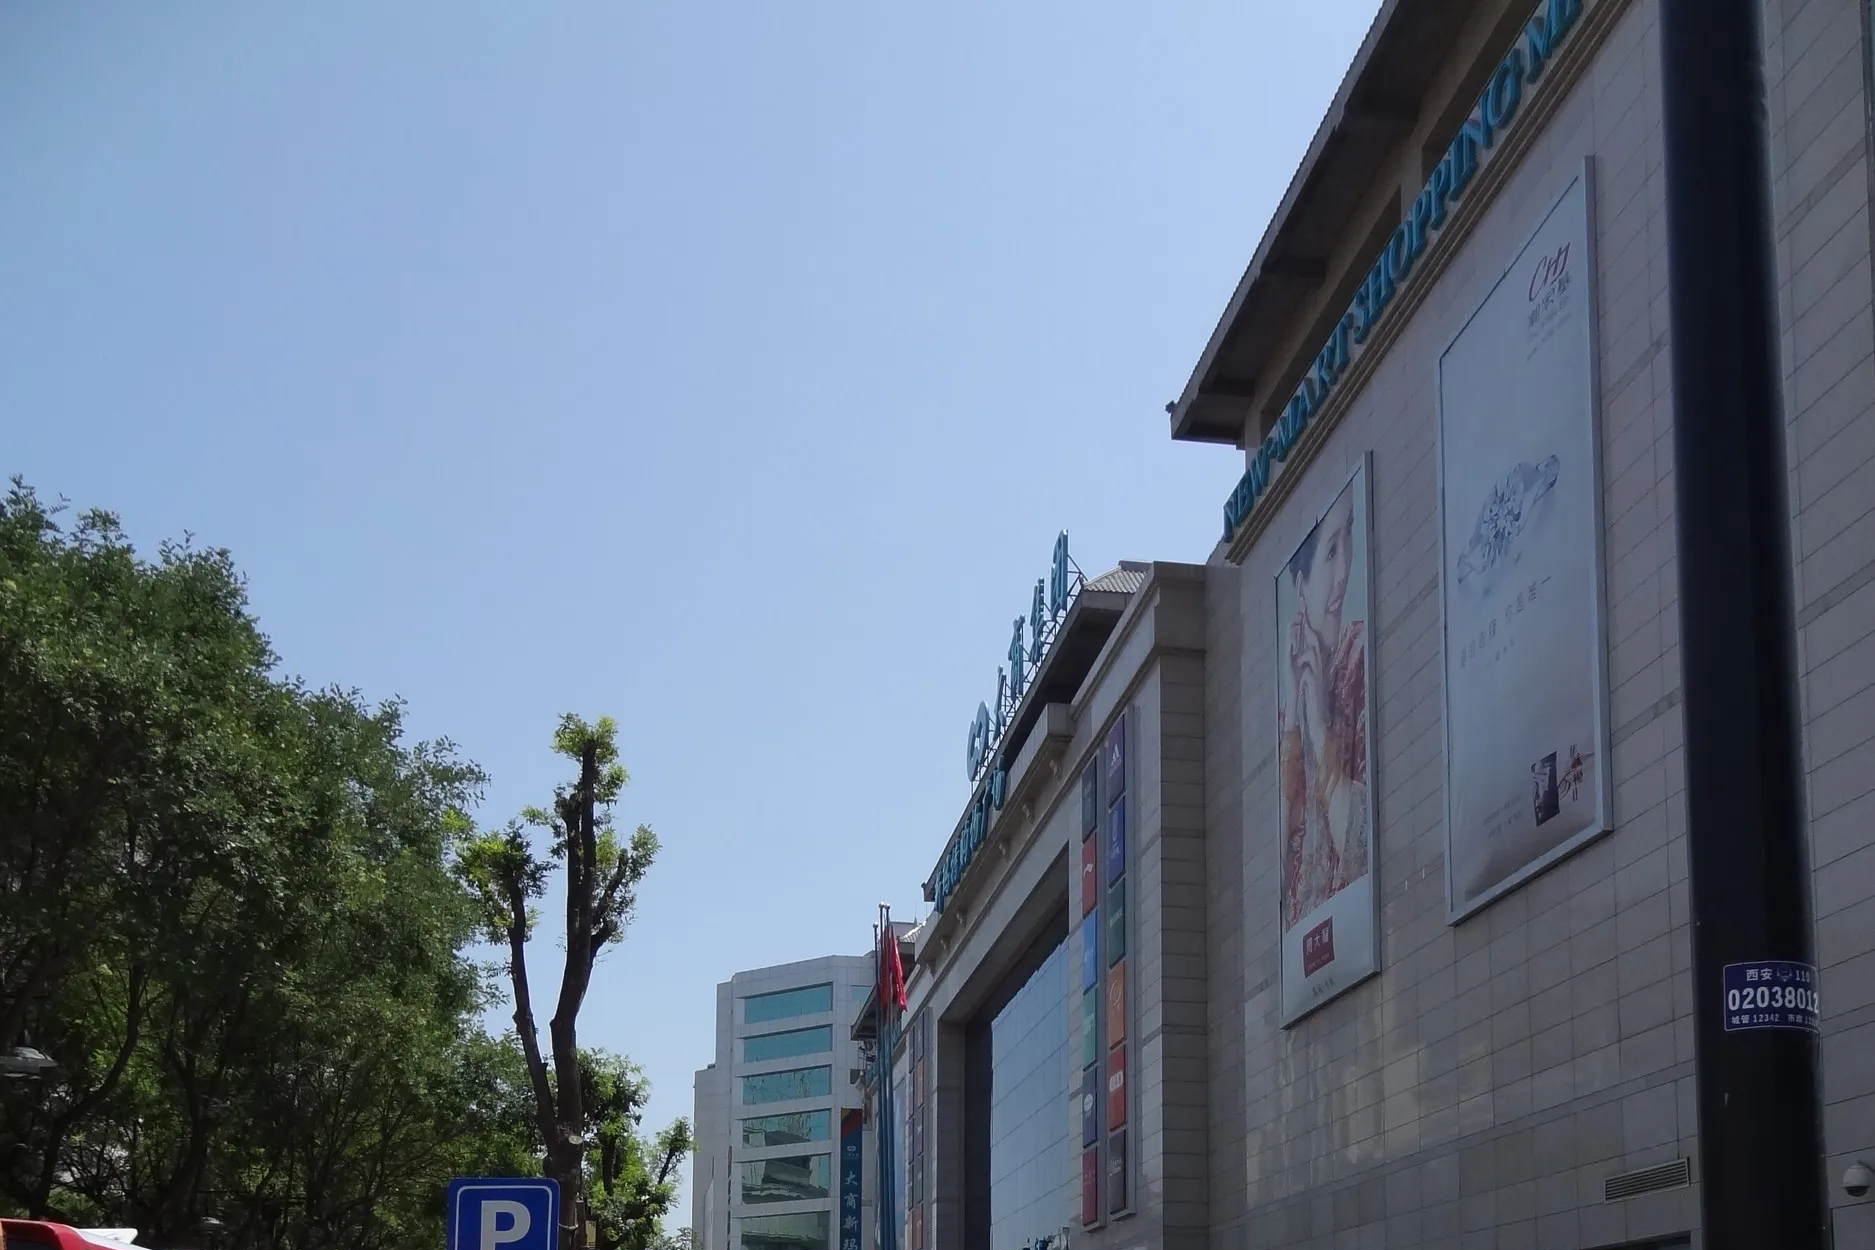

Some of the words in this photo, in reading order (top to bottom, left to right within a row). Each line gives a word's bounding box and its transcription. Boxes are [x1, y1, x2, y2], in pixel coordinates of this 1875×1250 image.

[1223, 313, 1350, 542] NEW-MART
[1353, 48, 1524, 344] SHOPPING
[1745, 968, 1773, 982] 西安
[1728, 986, 1820, 1014] 02038012
